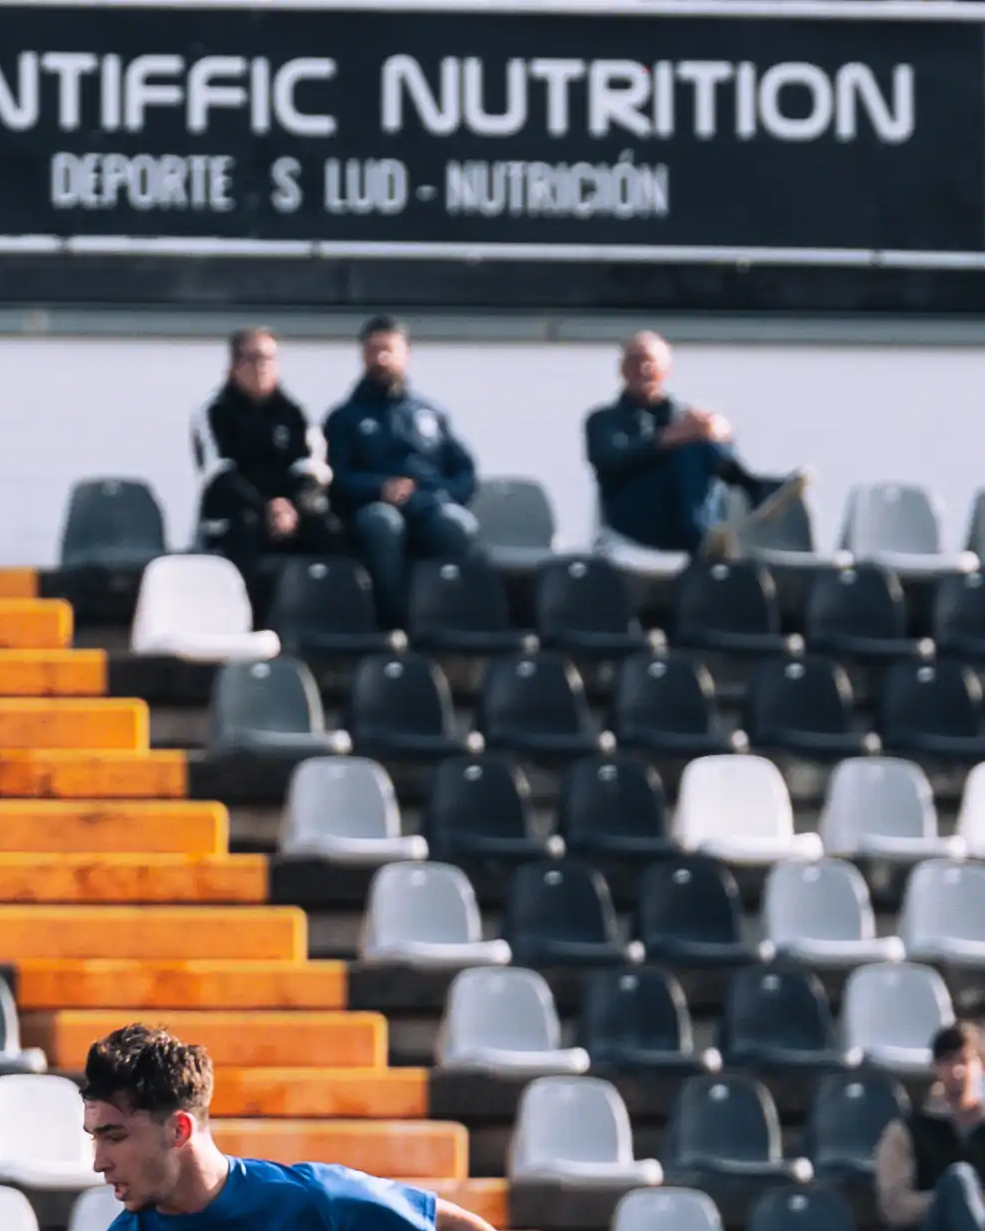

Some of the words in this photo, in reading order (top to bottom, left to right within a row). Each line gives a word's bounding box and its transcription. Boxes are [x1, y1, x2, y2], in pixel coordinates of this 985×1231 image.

[381, 54, 915, 142] NUTRITION
[51, 152, 234, 211] DEPORTE
[446, 150, 668, 217] NUTRICIÓN
